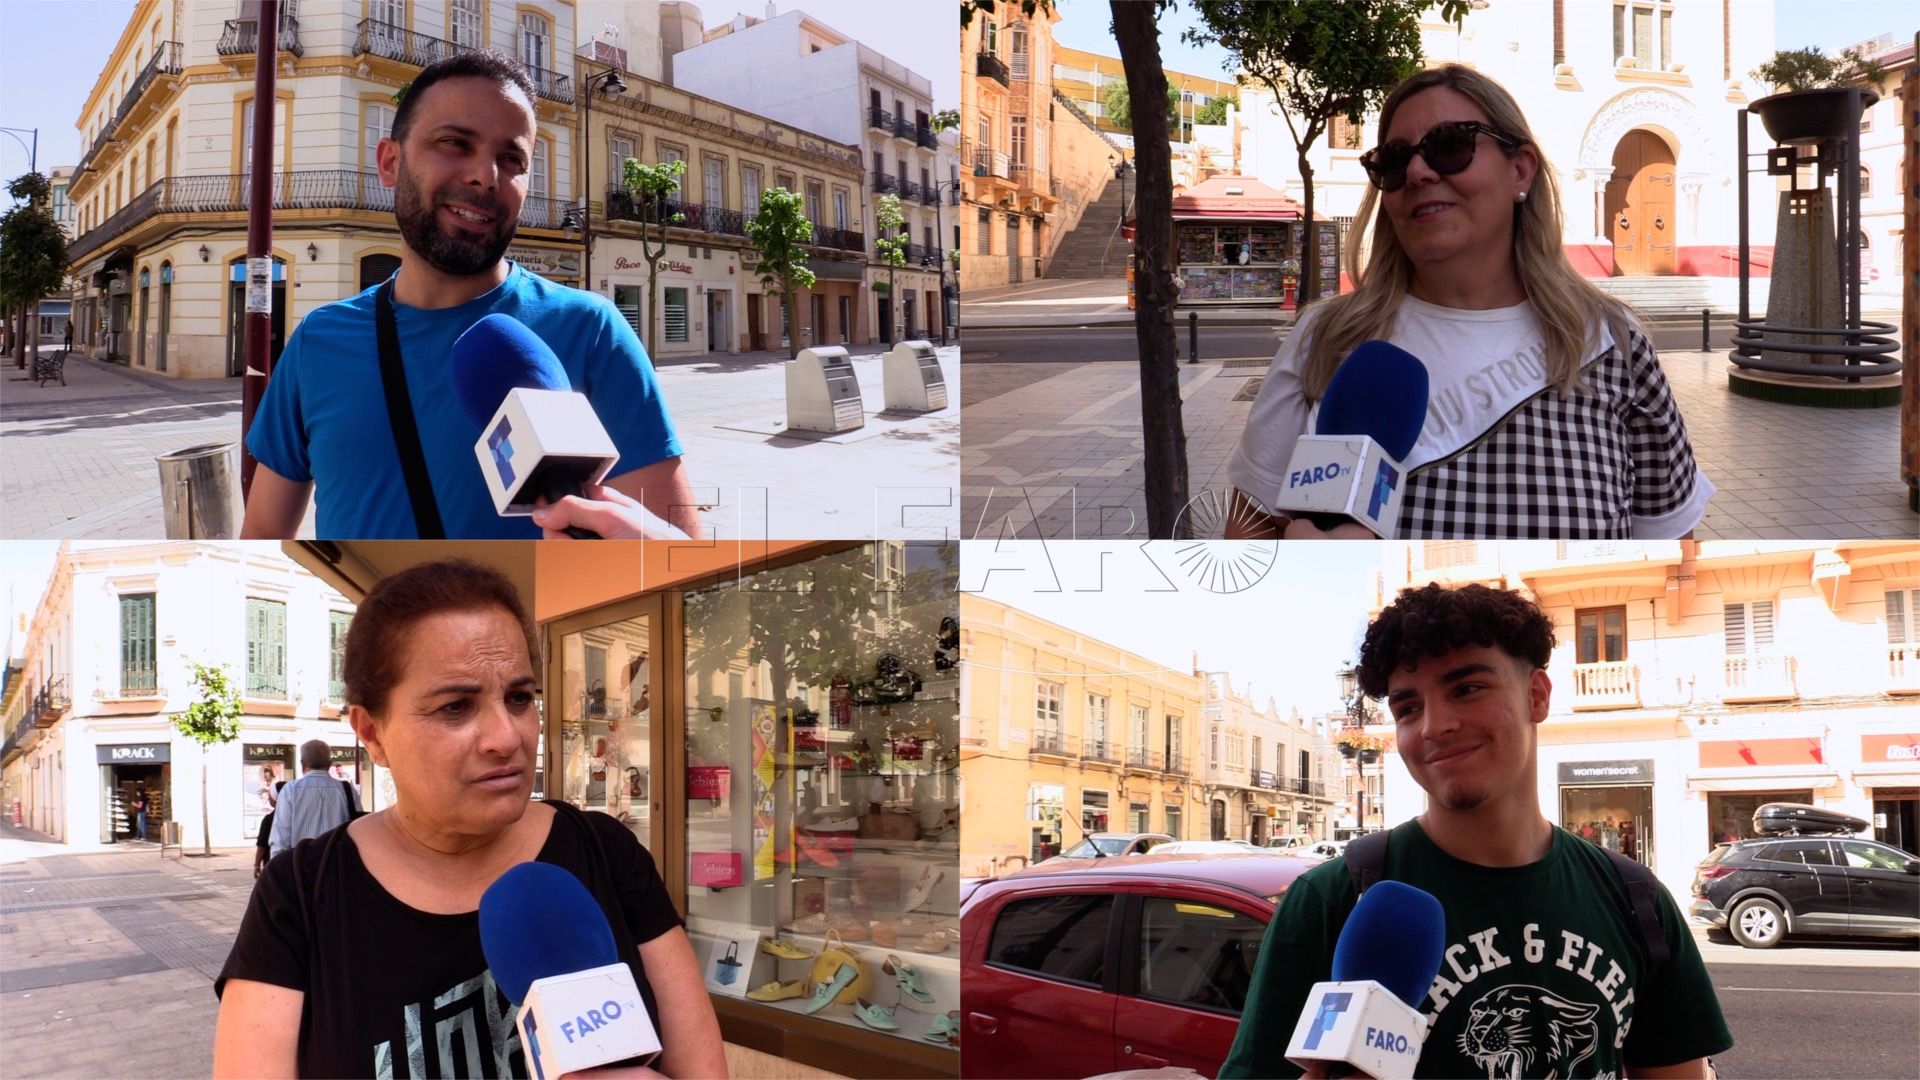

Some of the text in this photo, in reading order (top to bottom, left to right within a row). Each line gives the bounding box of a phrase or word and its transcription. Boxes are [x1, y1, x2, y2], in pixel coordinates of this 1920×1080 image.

[504, 254, 542, 264] ndalucia
[614, 257, 641, 270] Paco
[1464, 342, 1548, 412] STRON
[1290, 462, 1352, 489] FARO TV
[112, 747, 155, 759] KRACK
[249, 747, 284, 756] KRACK
[330, 750, 358, 759] KRAC
[1573, 766, 1639, 777] women'secret
[1423, 927, 1511, 1040] ACK
[1523, 923, 1545, 964] &
[560, 1000, 622, 1043] FARO
[1365, 1026, 1416, 1056] FARO TV
